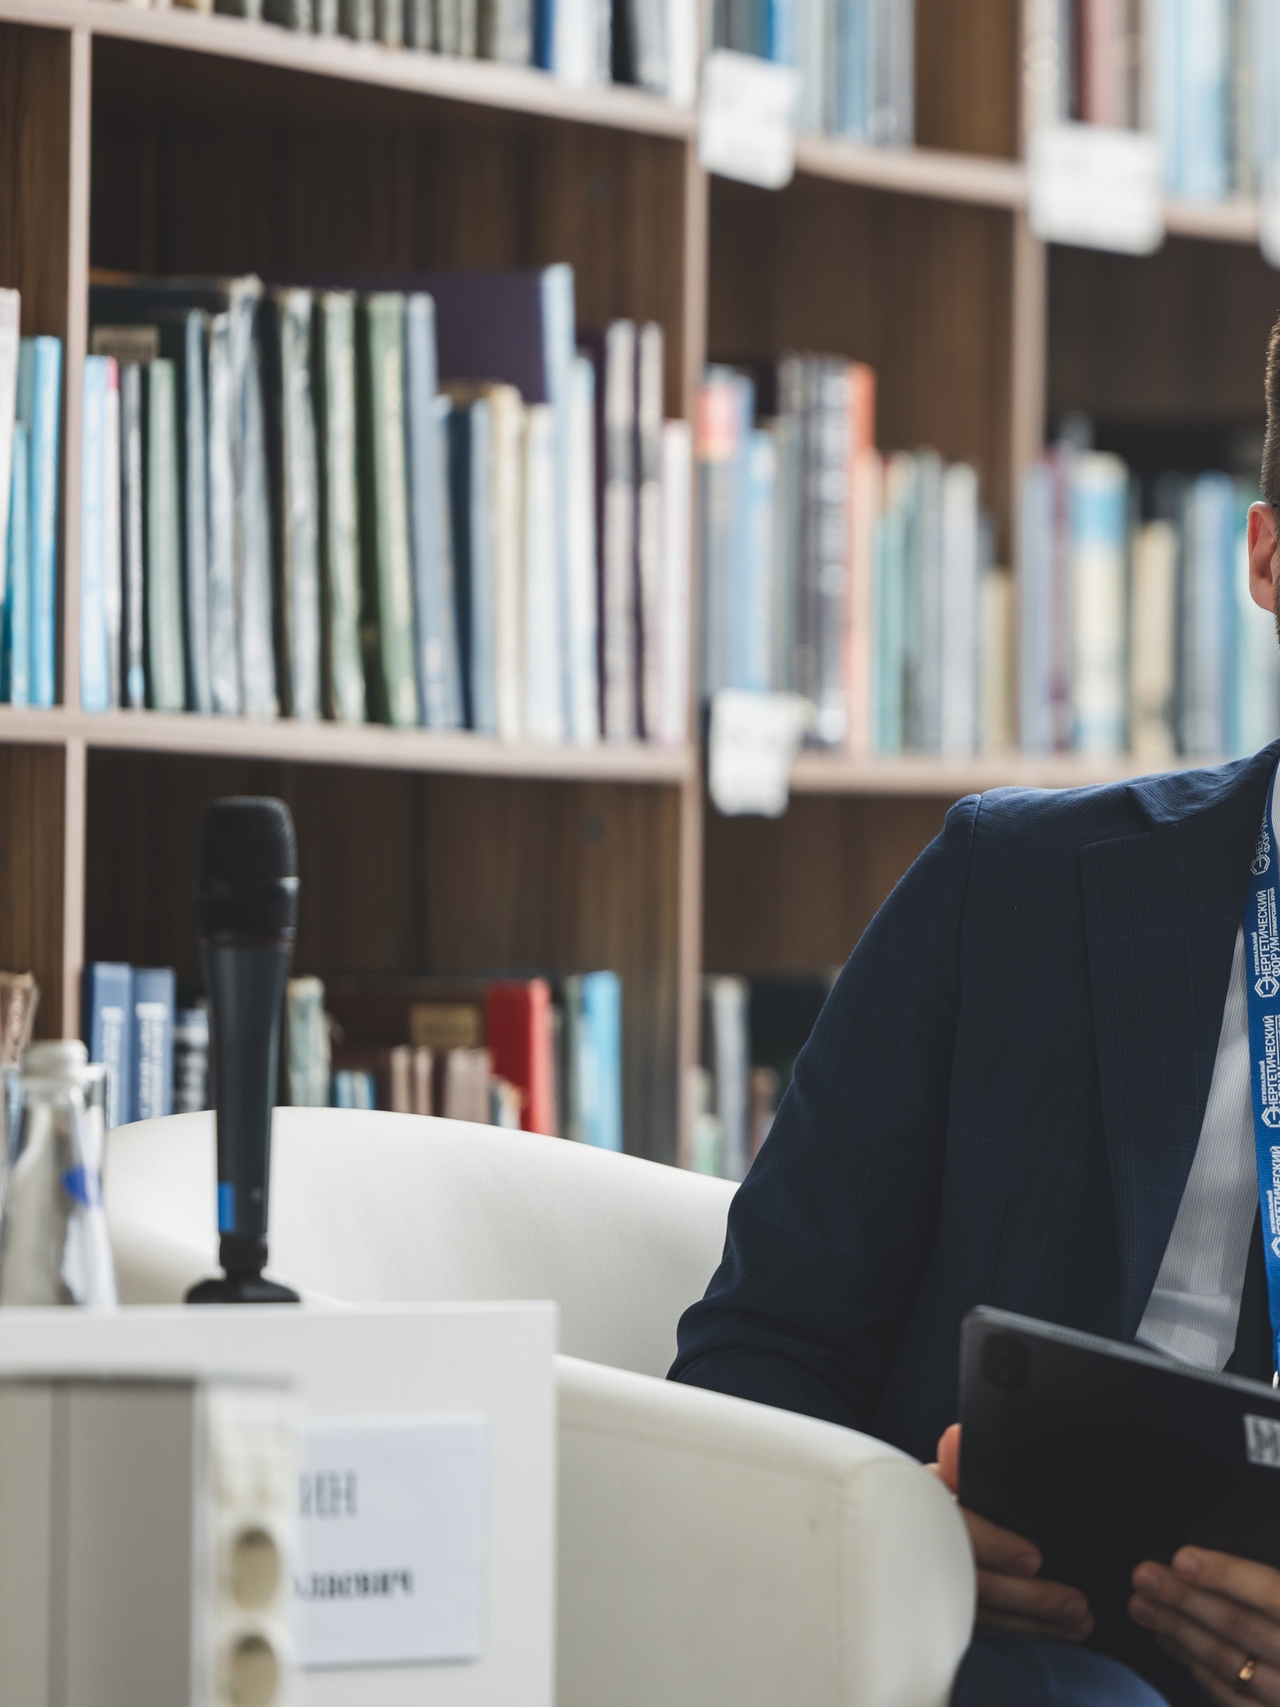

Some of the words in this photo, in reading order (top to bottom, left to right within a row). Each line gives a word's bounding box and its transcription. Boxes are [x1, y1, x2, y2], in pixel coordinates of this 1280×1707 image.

[1251, 931, 1260, 975] РЕГИОНАЛЬНЫЙ
[1258, 1060, 1267, 1105] РЕГИОНАЛЬНЫЙ
[299, 1470, 357, 1520] ИН
